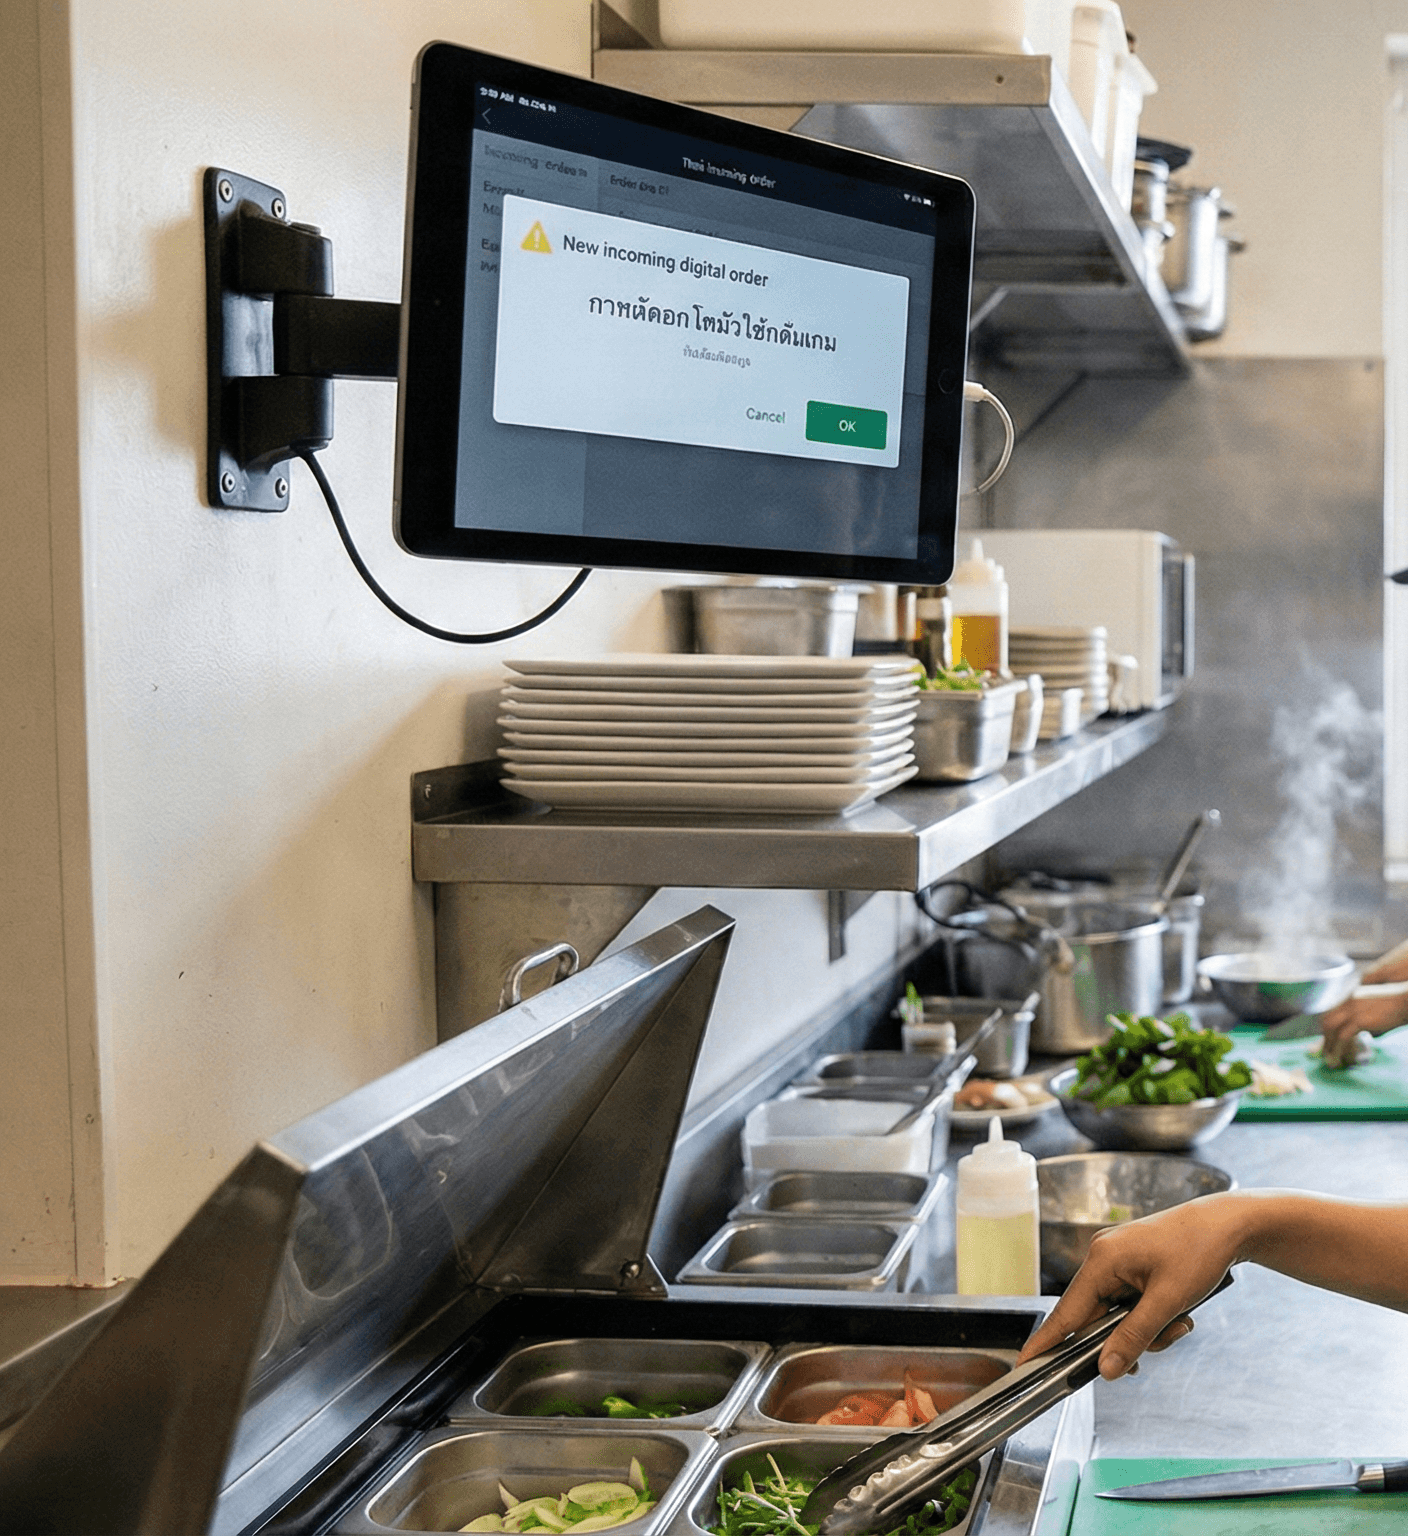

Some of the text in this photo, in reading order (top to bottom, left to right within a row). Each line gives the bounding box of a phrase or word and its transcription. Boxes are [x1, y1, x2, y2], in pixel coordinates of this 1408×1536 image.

[563, 235, 769, 287] New incoming digital order
[746, 407, 786, 424] Cancel
[838, 419, 857, 433] OK
